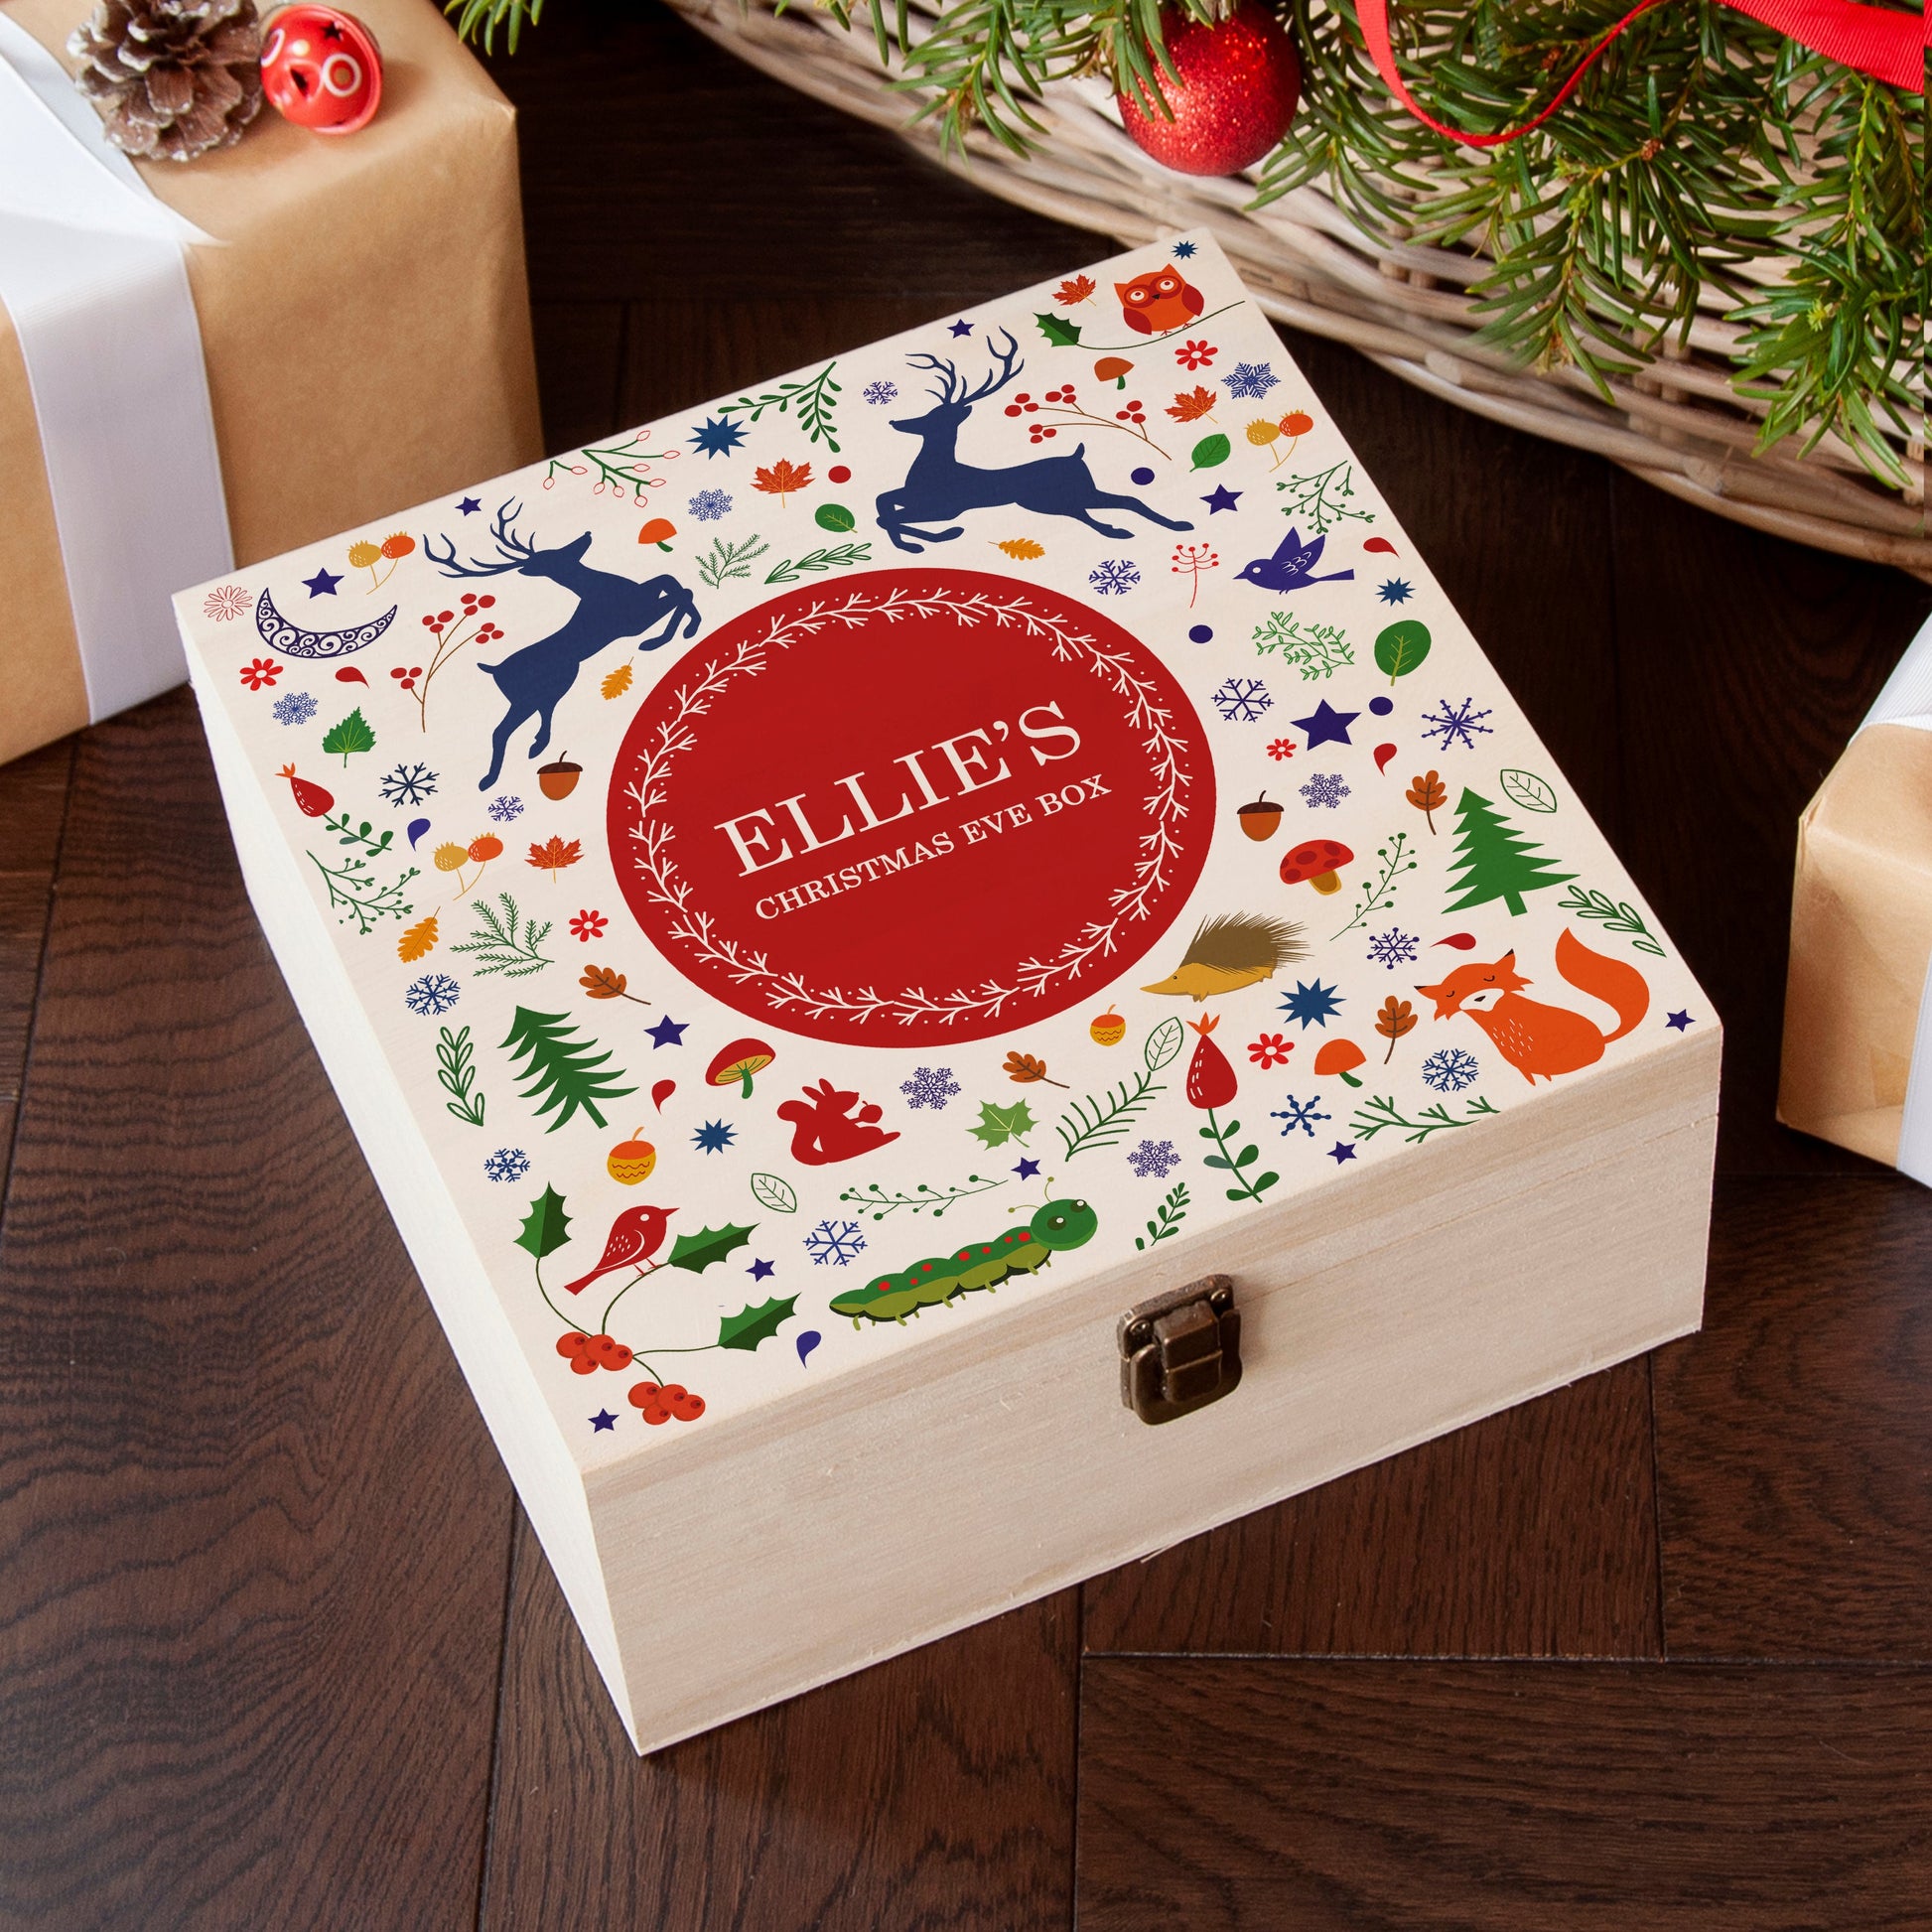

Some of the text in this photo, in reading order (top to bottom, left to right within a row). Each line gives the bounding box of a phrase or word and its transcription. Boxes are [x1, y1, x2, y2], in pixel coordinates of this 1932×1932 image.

[713, 700, 1082, 878] ELLIE’S
[756, 773, 1112, 920] CHRISTMAS EVE BOX
